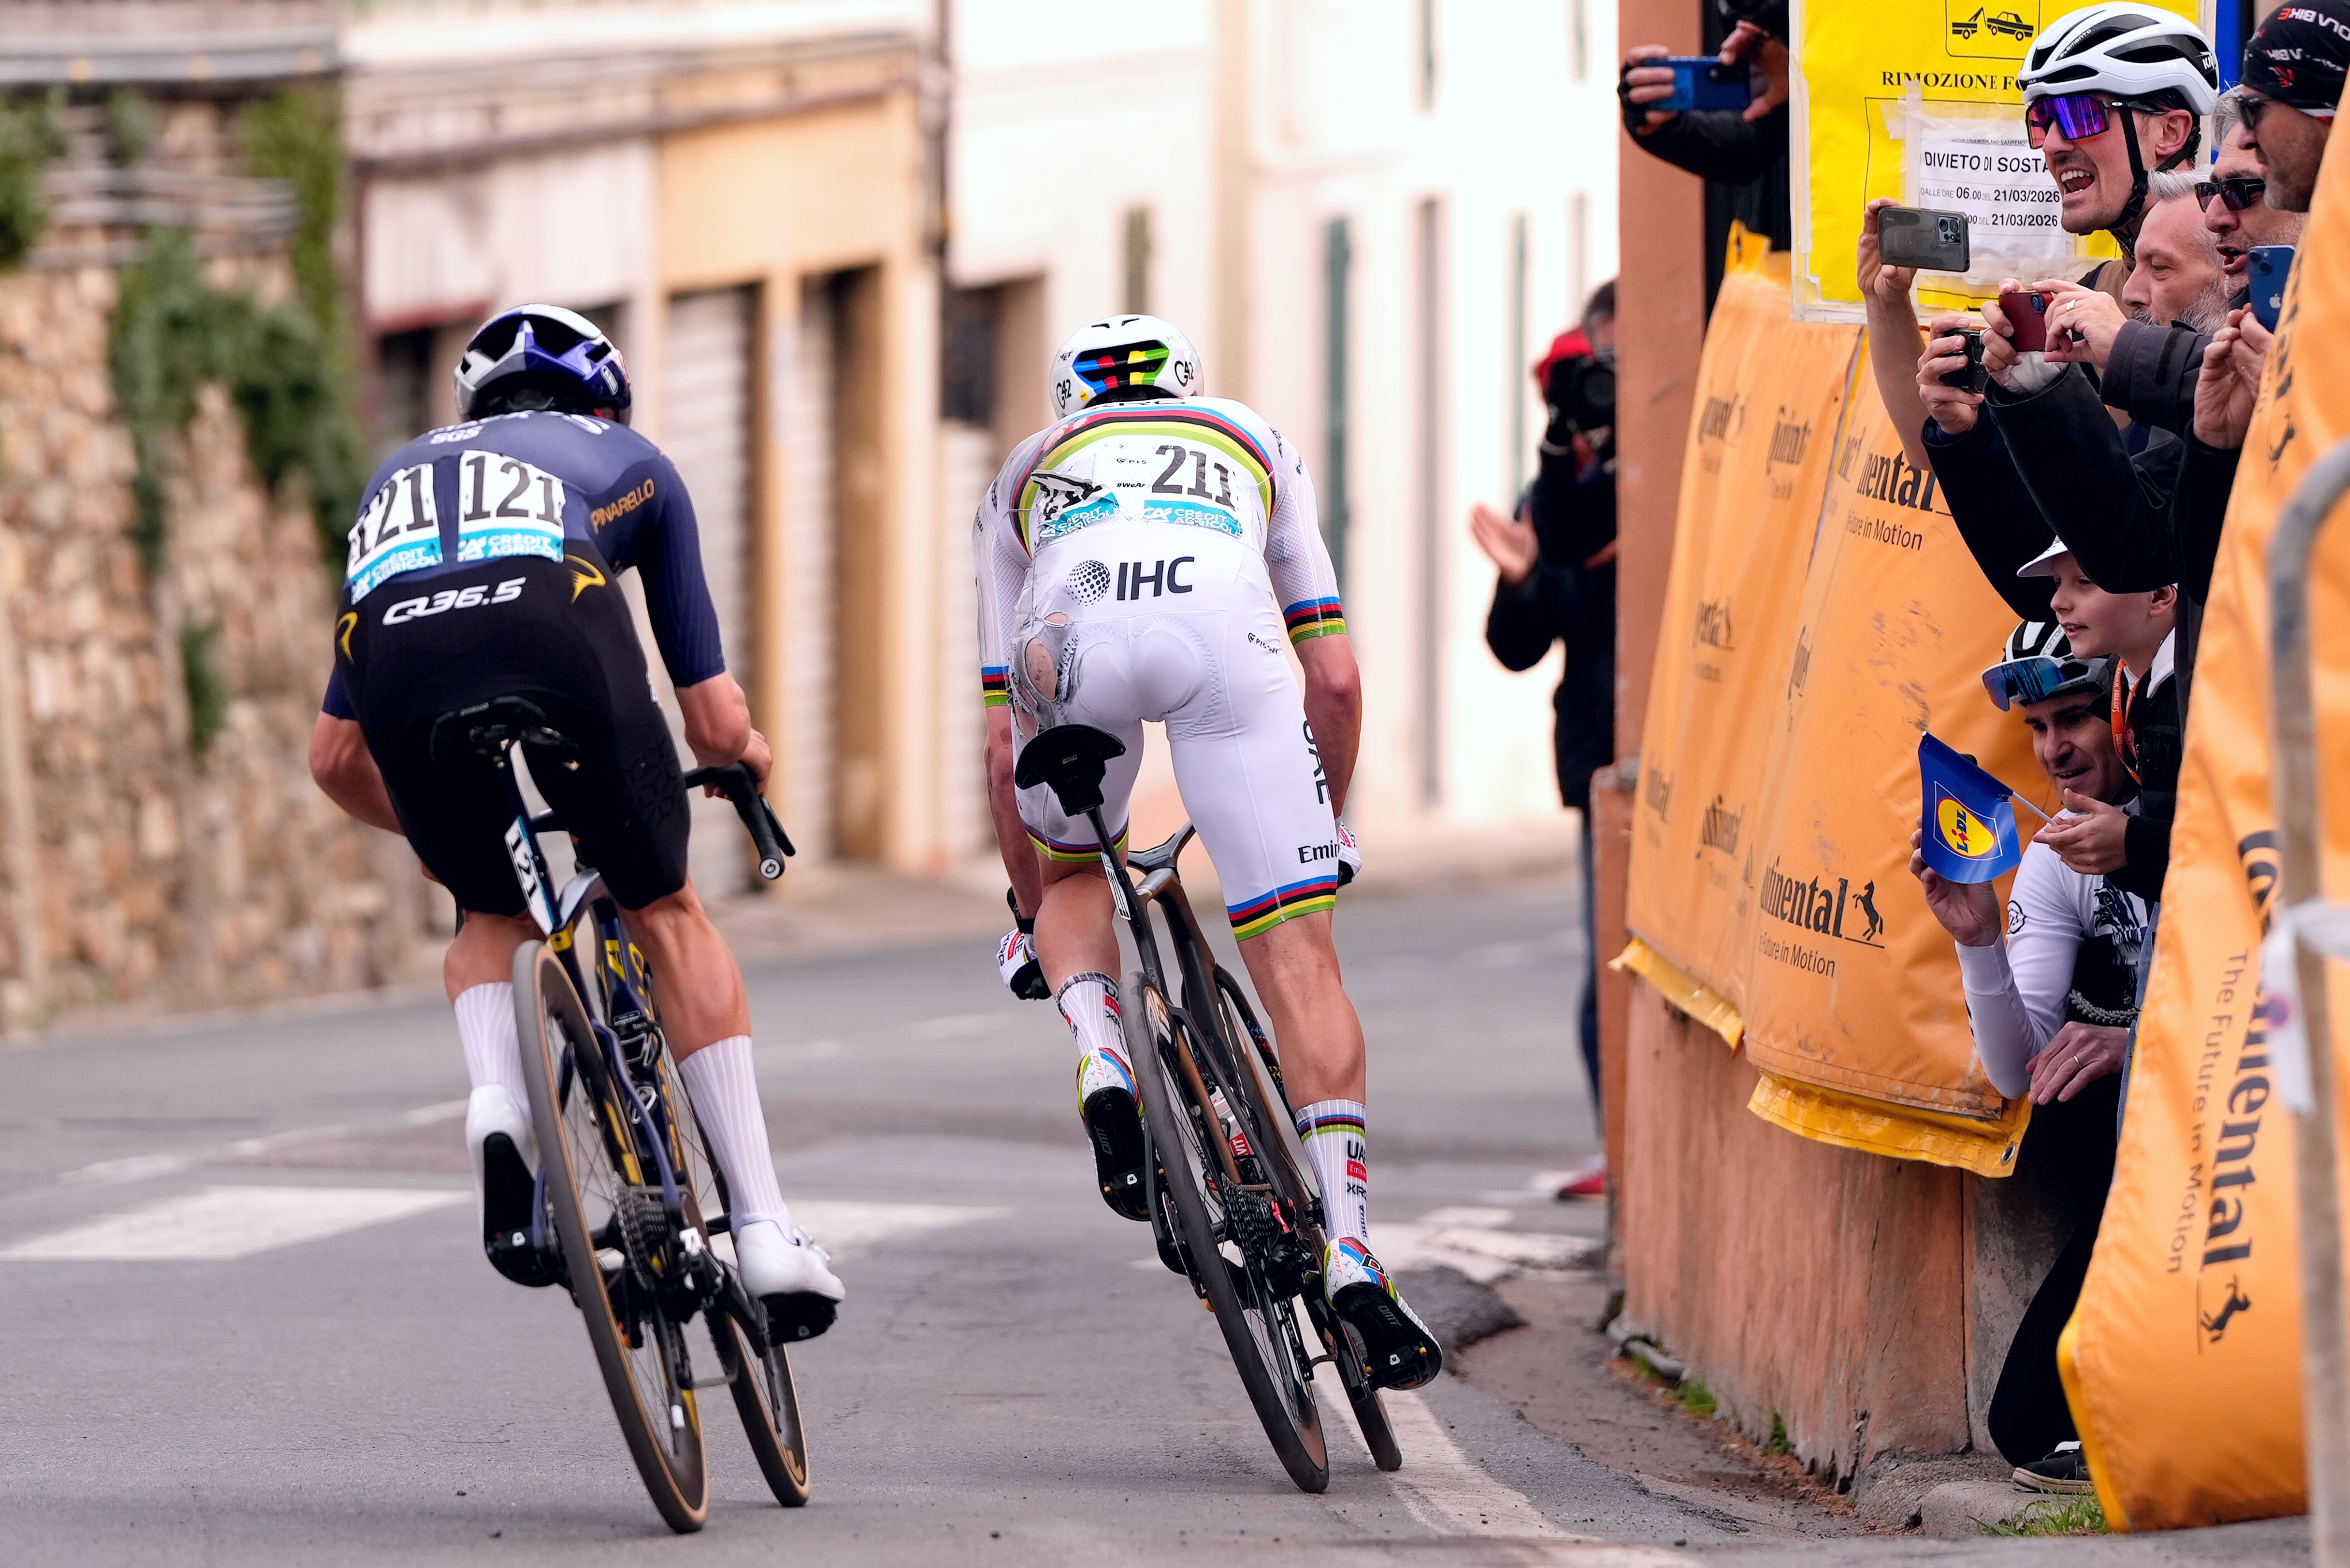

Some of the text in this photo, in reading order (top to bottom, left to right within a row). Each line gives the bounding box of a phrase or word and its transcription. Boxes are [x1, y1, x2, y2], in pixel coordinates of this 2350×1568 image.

[1881, 71, 1998, 90] RIMOZIONE
[1924, 151, 1980, 170] DIVIETO
[1984, 156, 1992, 171] DI
[1920, 187, 2060, 203] DALLE ORE 06.00 DEL 21/03/2026
[1979, 216, 1990, 225] DEL
[1991, 214, 2057, 227] 21/03/2026
[1058, 351, 1073, 362] MET
[464, 455, 559, 526] 121
[1151, 445, 1236, 512] 211
[590, 477, 655, 535] PINARELLO
[1174, 508, 1228, 524] CRÉDIT
[489, 532, 551, 546] CRÉDIT
[1173, 516, 1242, 539] AGRICOL
[1872, 518, 1922, 551] Motion
[488, 543, 564, 564] AGRICOL
[1116, 556, 1195, 601] IHC
[382, 576, 527, 626] Q36.5
[2112, 667, 2121, 713] Sanremo Women
[1297, 839, 1339, 864] Emir
[1780, 941, 1790, 964] in
[1790, 944, 1836, 977] Motion
[1092, 1055, 1105, 1079] DMT
[2166, 947, 2249, 1274] The Future in Motion
[1094, 1125, 1113, 1156] DMT
[1332, 1249, 1343, 1275] DMT
[1377, 1304, 1402, 1327] DMT
